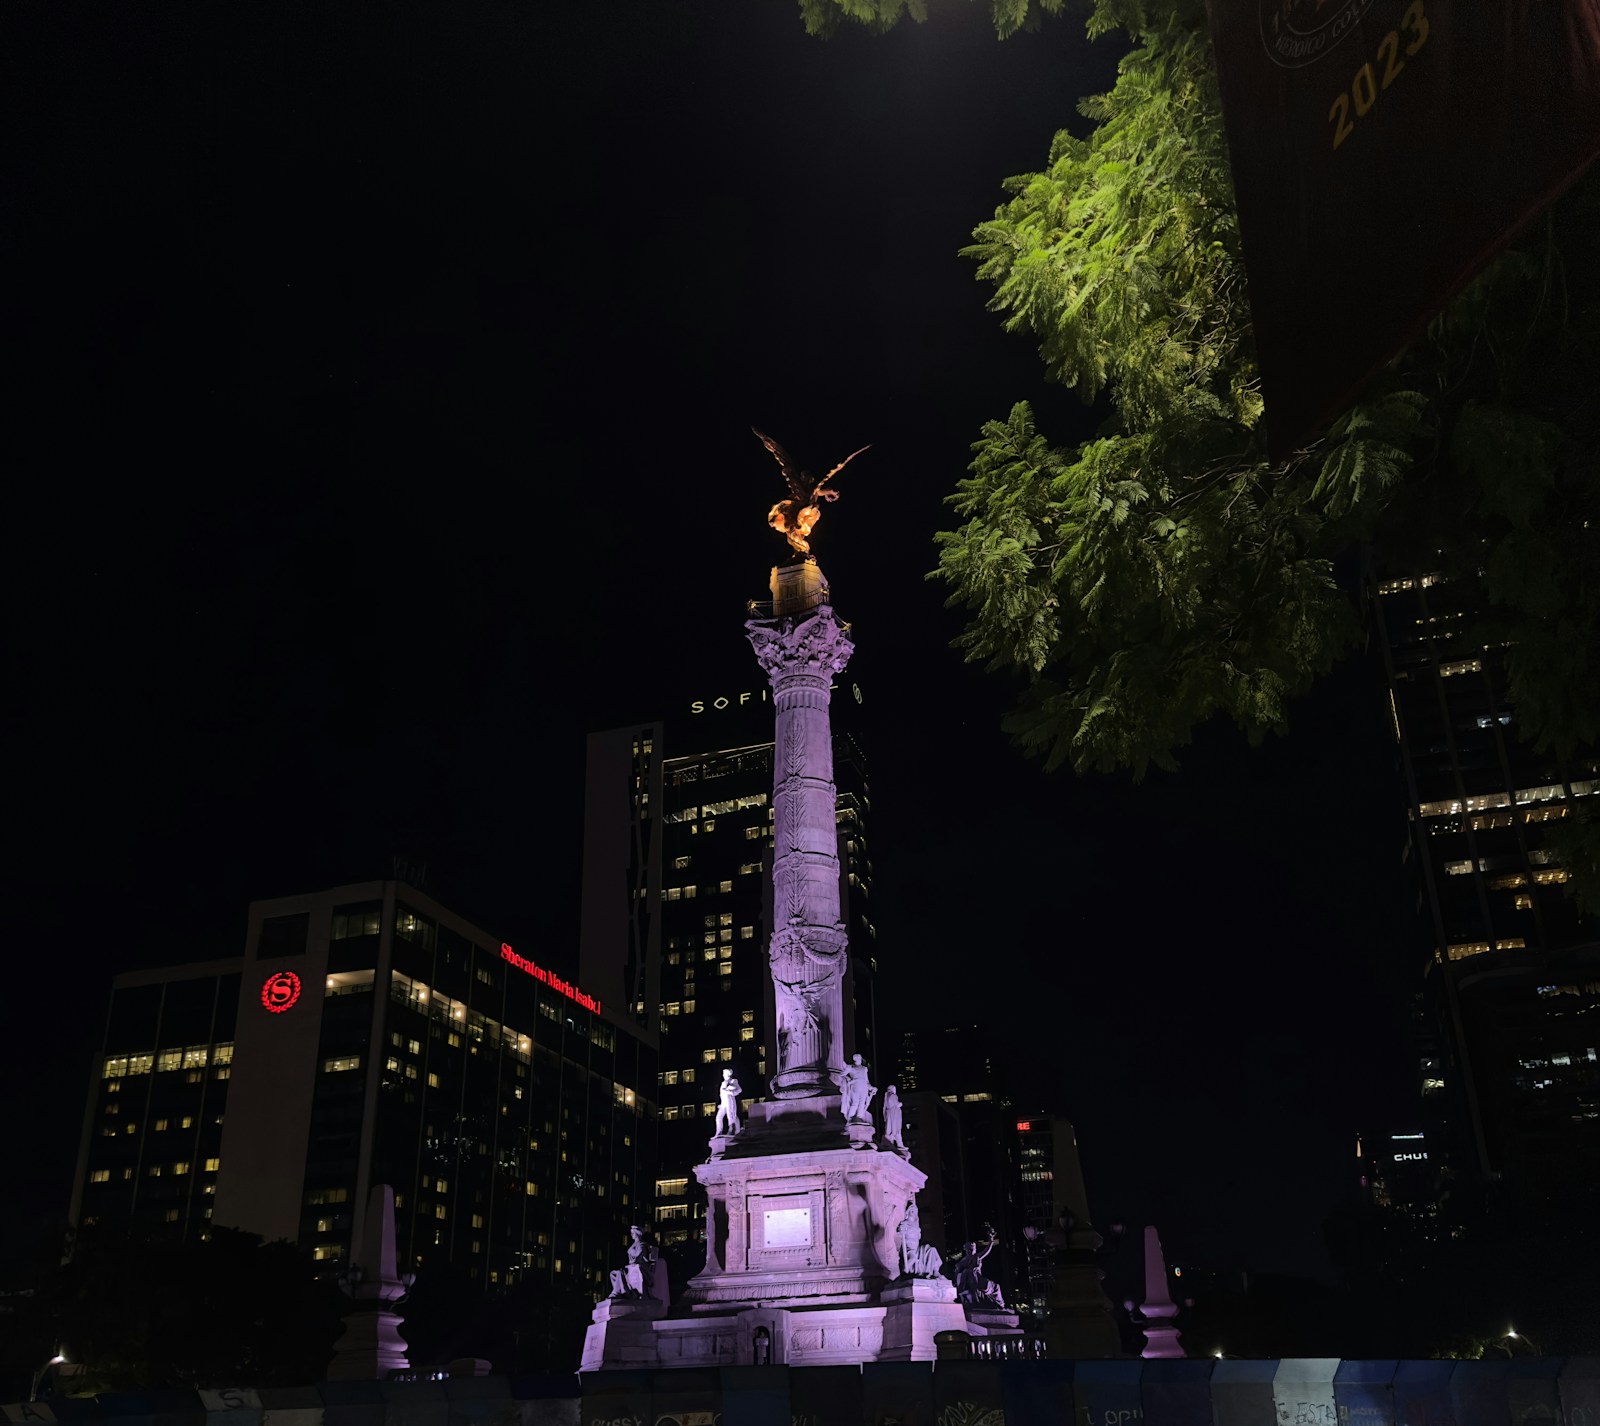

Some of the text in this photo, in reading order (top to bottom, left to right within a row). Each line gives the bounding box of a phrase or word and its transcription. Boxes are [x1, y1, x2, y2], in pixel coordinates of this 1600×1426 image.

[1328, 0, 1430, 150] 2023
[500, 942, 547, 982] Sheraton
[547, 968, 574, 999] Maria
